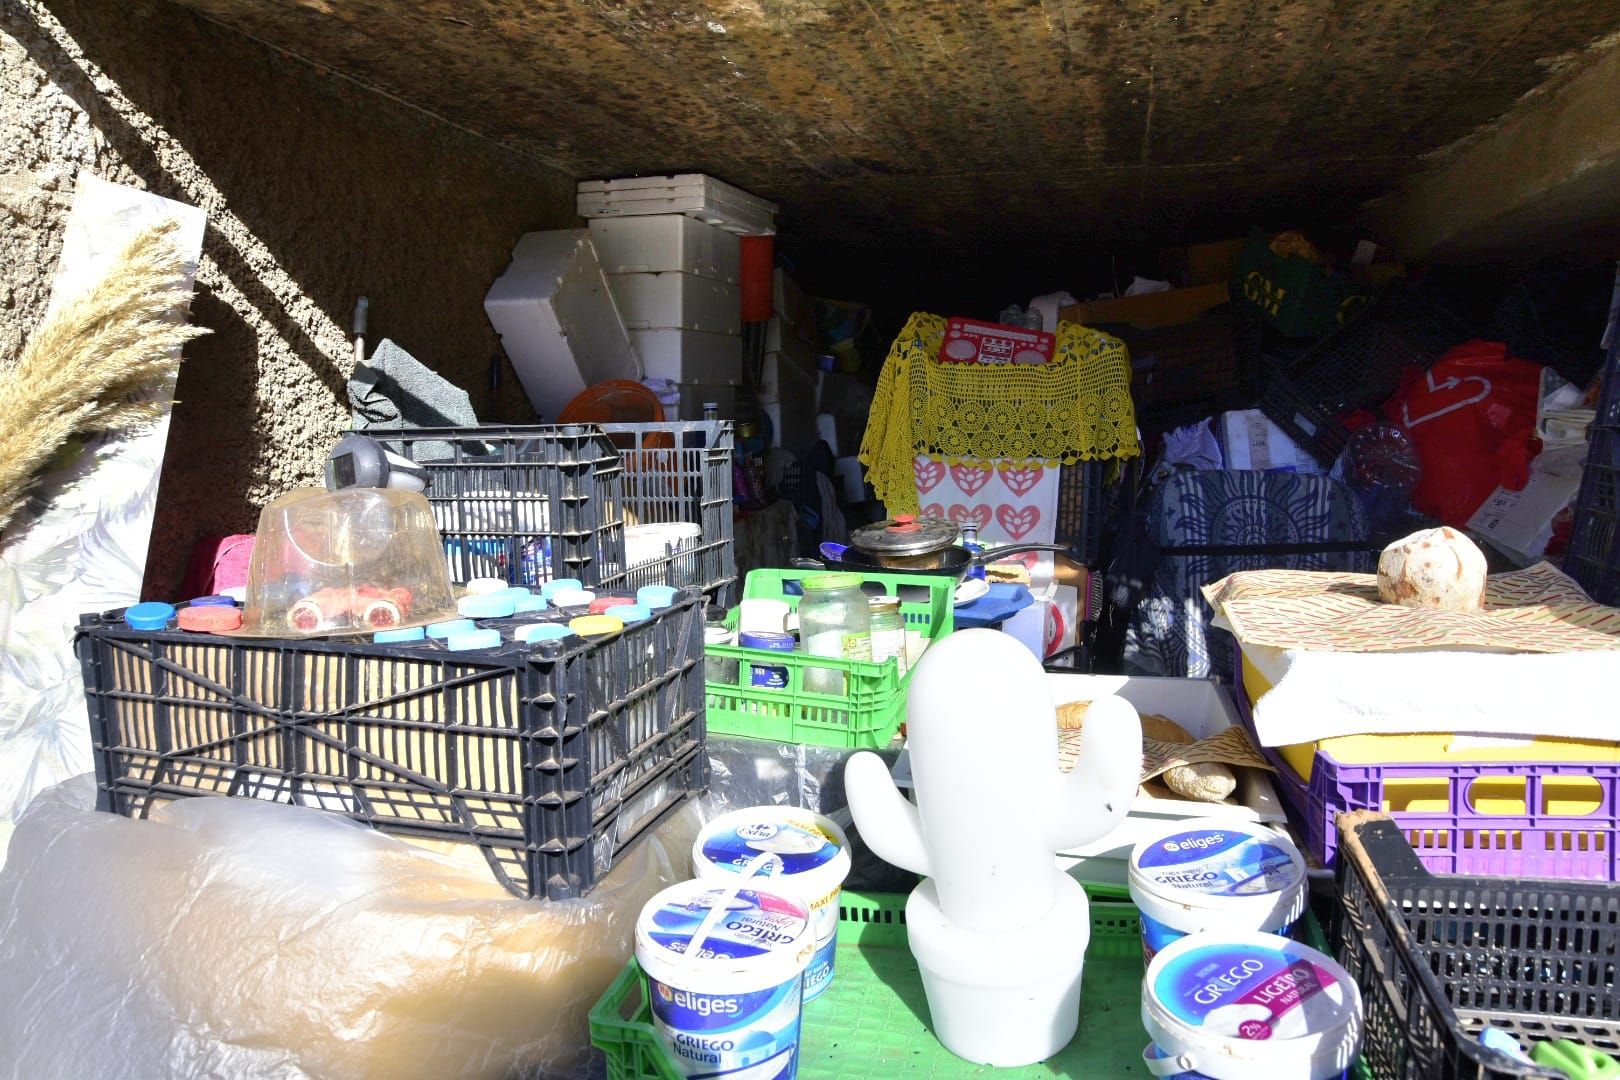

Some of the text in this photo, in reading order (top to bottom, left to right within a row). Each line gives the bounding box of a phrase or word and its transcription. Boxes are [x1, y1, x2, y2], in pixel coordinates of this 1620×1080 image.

[1180, 833, 1223, 850] eliges
[1154, 871, 1218, 884] GRIEGO
[726, 921, 794, 944] GRIEGO
[740, 916, 782, 931] Natural
[1193, 959, 1264, 1005] GRIEGO
[674, 990, 738, 1015] eliges
[676, 1032, 734, 1050] GRIEGO
[673, 1041, 722, 1063] Natural
